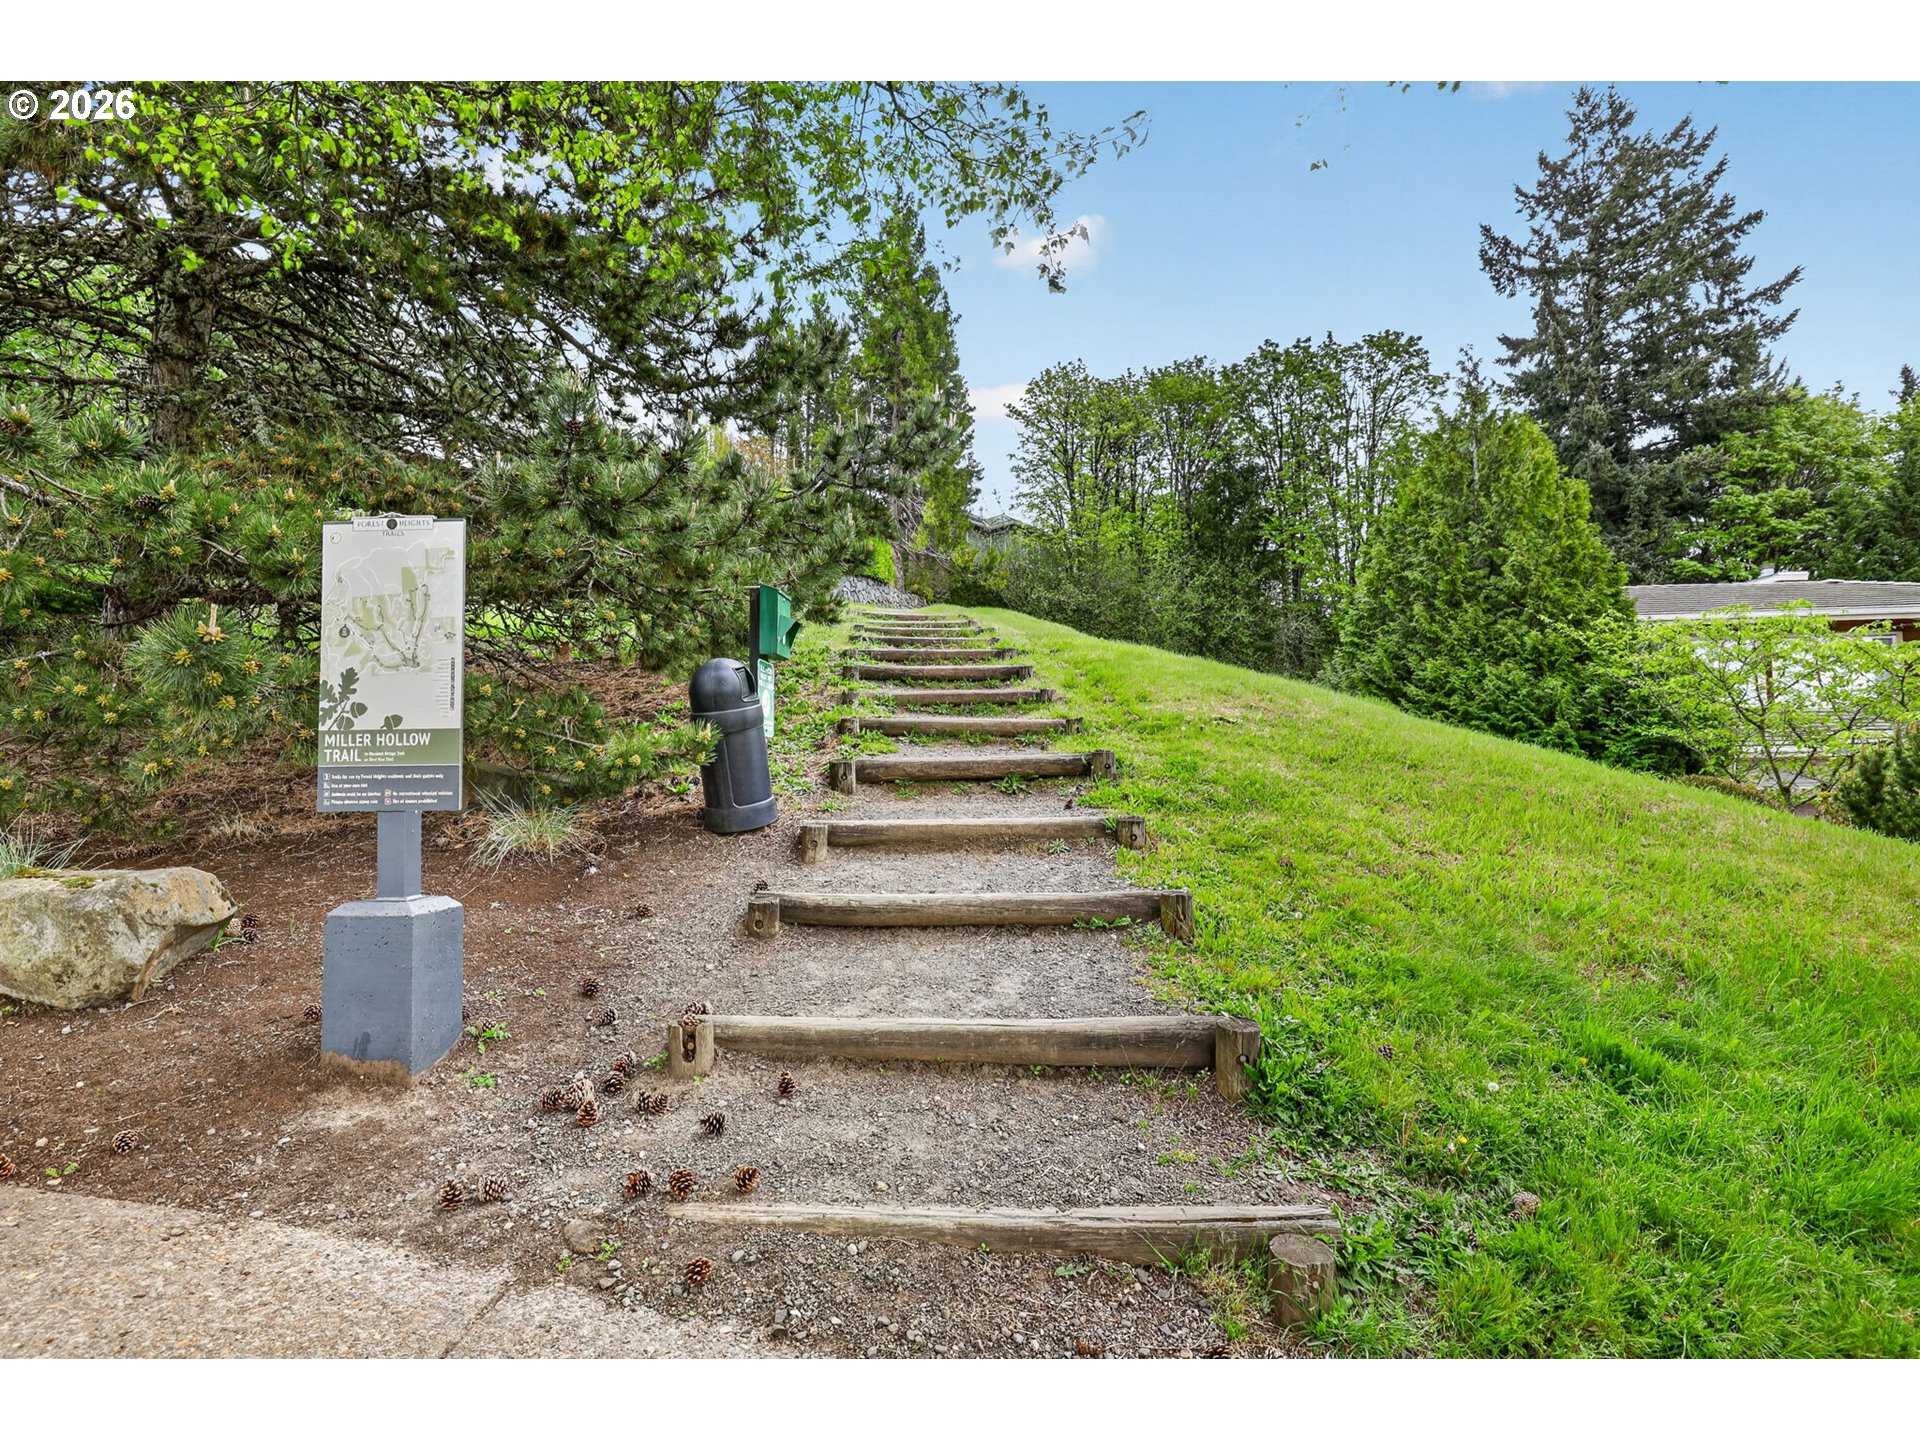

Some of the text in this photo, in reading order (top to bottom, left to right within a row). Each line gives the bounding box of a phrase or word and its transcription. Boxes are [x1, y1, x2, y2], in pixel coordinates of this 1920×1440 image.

[357, 519, 430, 528] FOREST HEIGHTS
[324, 732, 431, 747] MILLER HOLLOW
[324, 749, 362, 762] TRAIL
